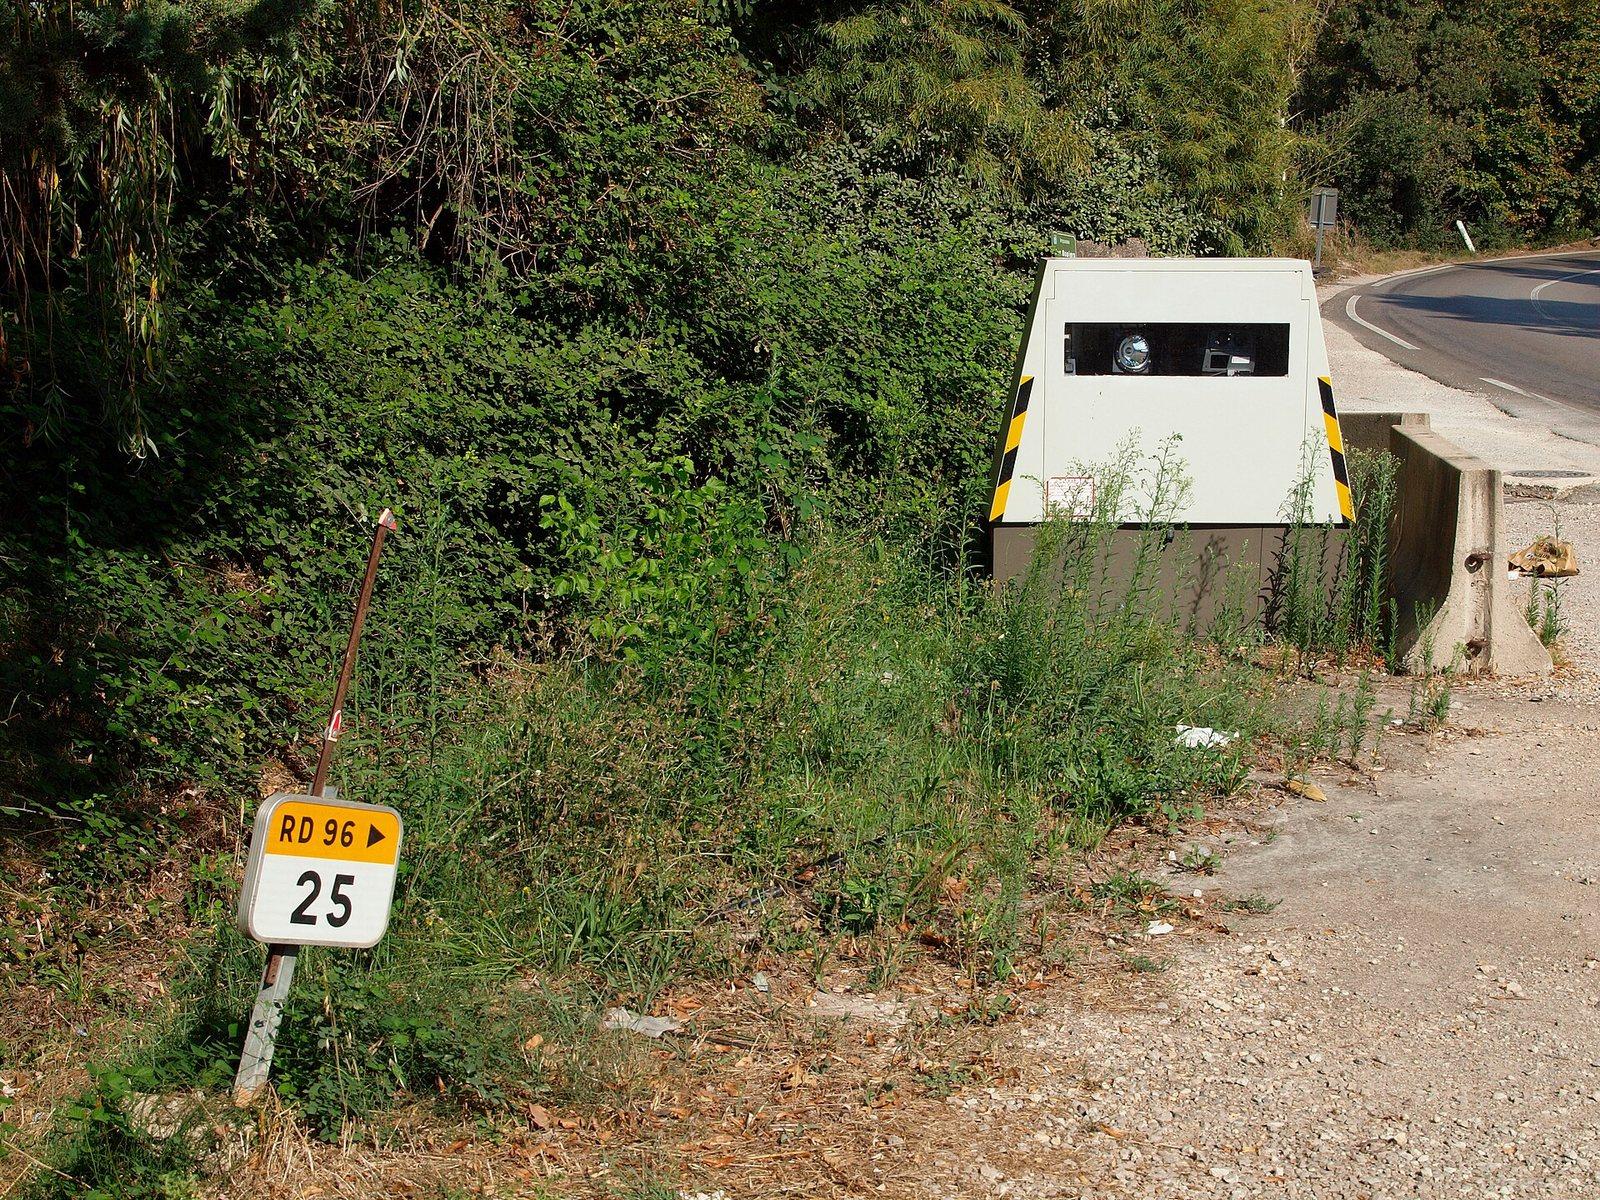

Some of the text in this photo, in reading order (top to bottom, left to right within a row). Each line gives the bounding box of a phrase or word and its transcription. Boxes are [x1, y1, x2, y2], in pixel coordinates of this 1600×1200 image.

[279, 814, 356, 848] RD 96
[289, 870, 355, 928] 25
